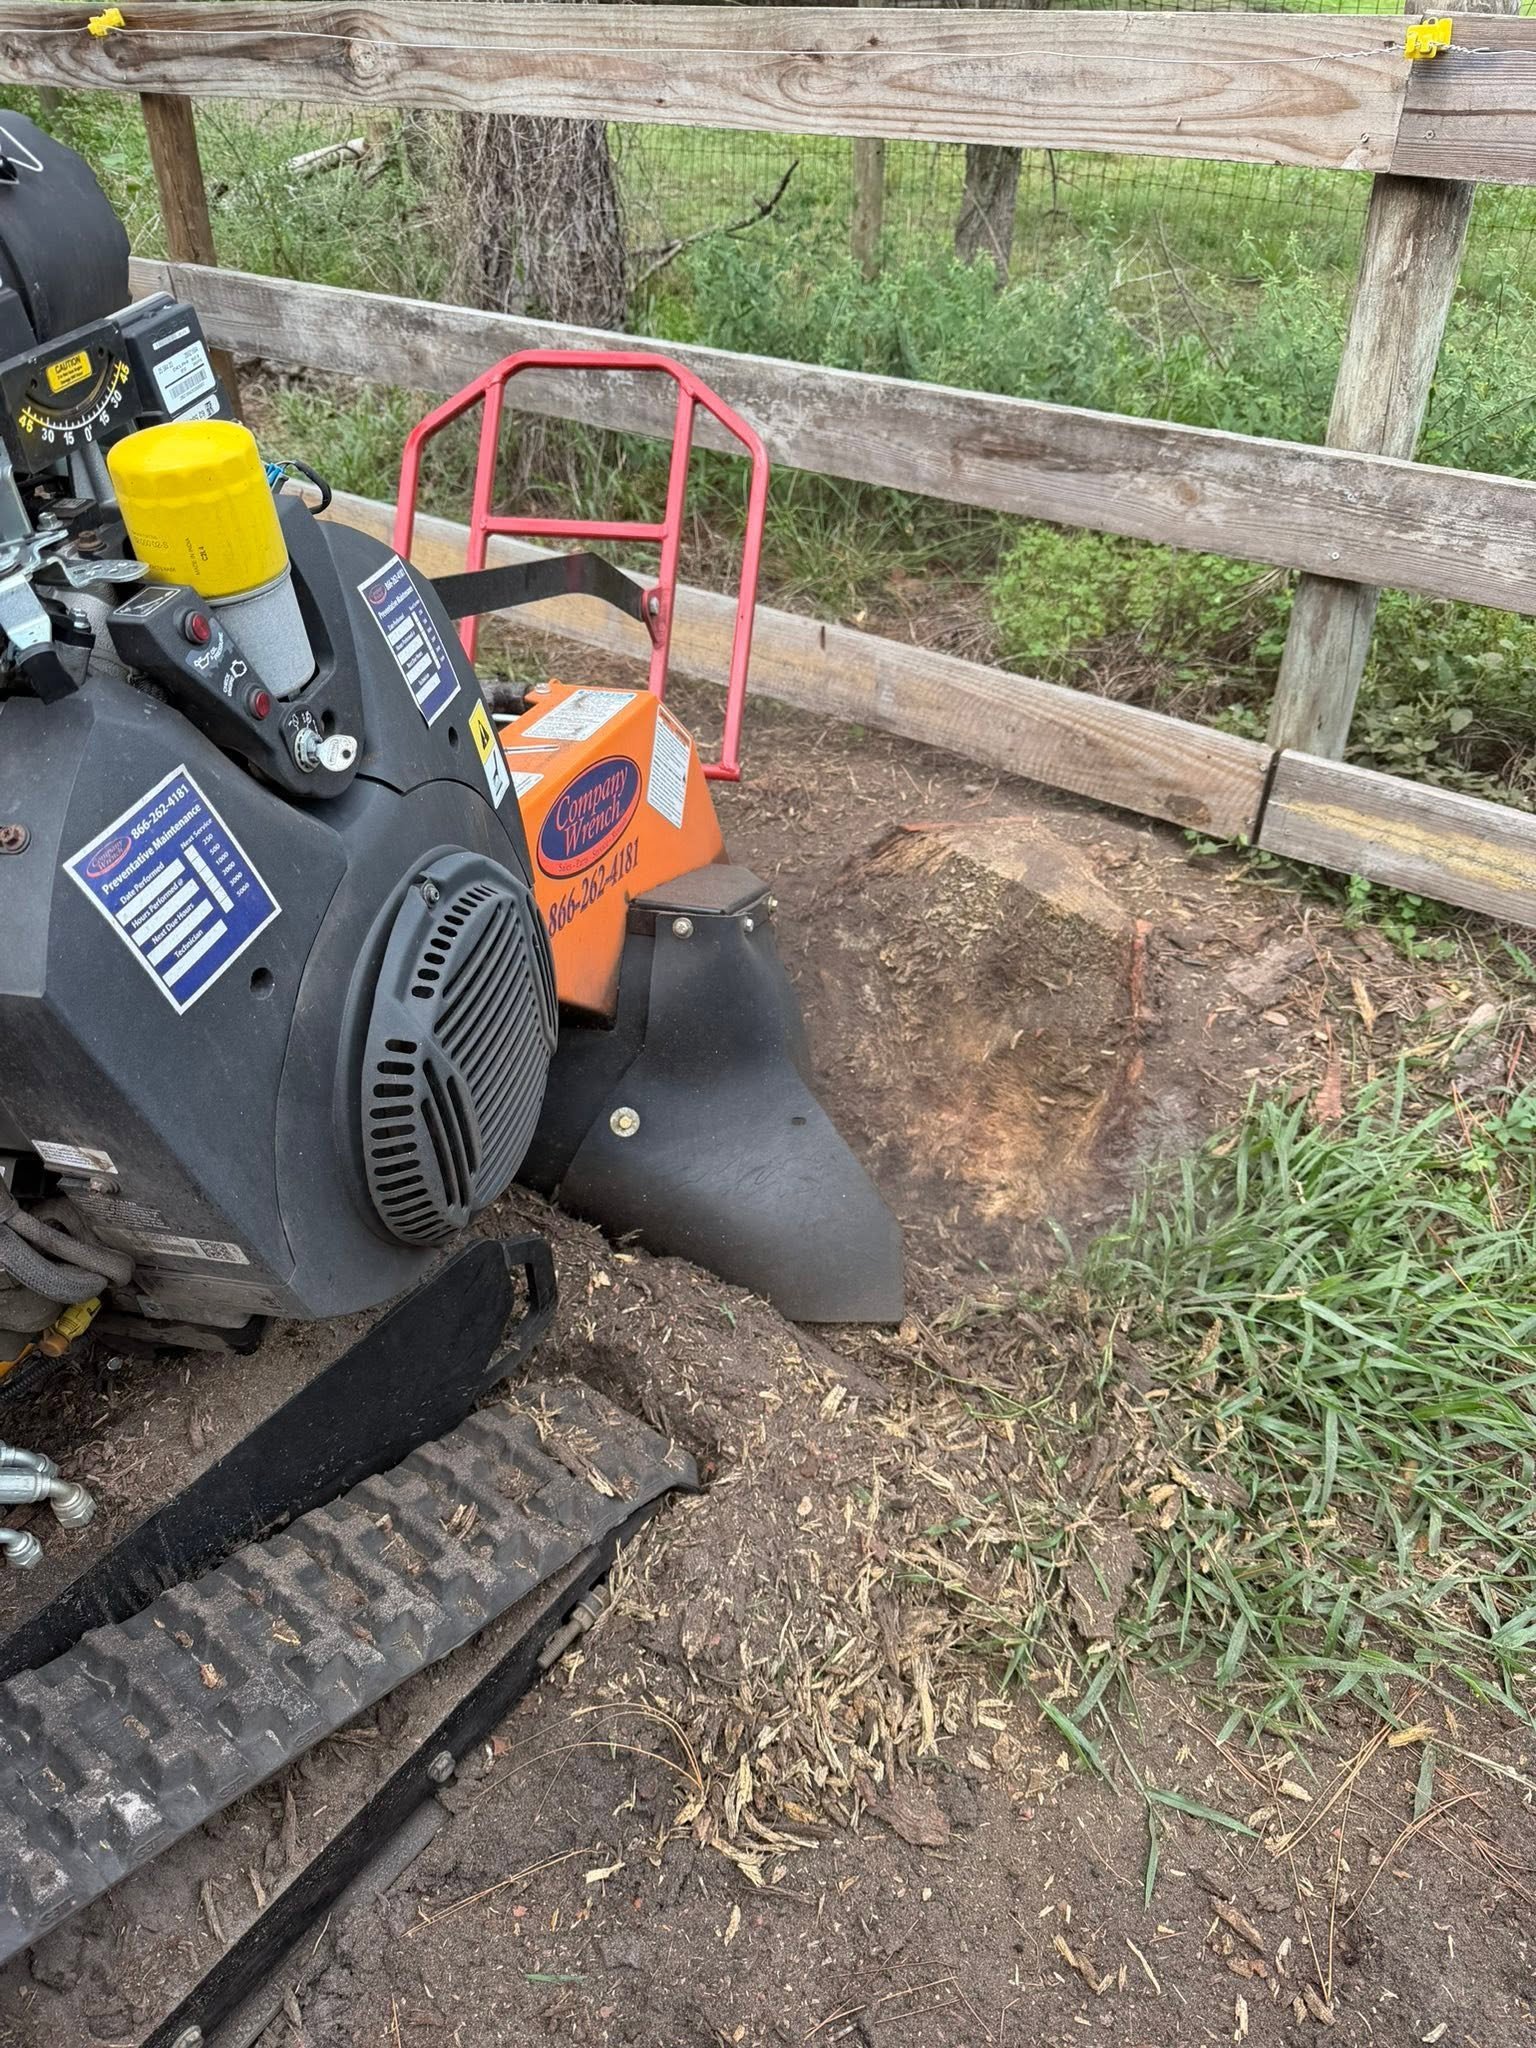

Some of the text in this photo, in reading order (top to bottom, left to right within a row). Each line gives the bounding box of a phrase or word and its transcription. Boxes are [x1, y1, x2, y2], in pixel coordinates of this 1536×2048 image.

[55, 355, 81, 374] CAUTION
[41, 428, 55, 443] 30
[63, 431, 75, 445] 15
[100, 410, 110, 426] 15
[111, 391, 122, 408] 30
[119, 363, 130, 384] 45
[131, 783, 190, 840] 866-262-4181
[556, 766, 628, 831] Company
[180, 818, 213, 850] Next Service
[202, 833, 214, 846] 250
[564, 792, 621, 857] Wrench
[101, 803, 202, 895] Preventative Maintenance
[209, 843, 221, 856] 500
[215, 851, 229, 866] 1000
[120, 861, 165, 905] Date Performed
[222, 861, 236, 877] 2000
[229, 871, 243, 887] 3000
[548, 837, 639, 938] 866-262-4181
[131, 912, 151, 929] Hours
[148, 882, 180, 913] Performed
[236, 882, 250, 898] 5000
[151, 902, 195, 945] Next Due Hours
[174, 929, 204, 958] Technician
